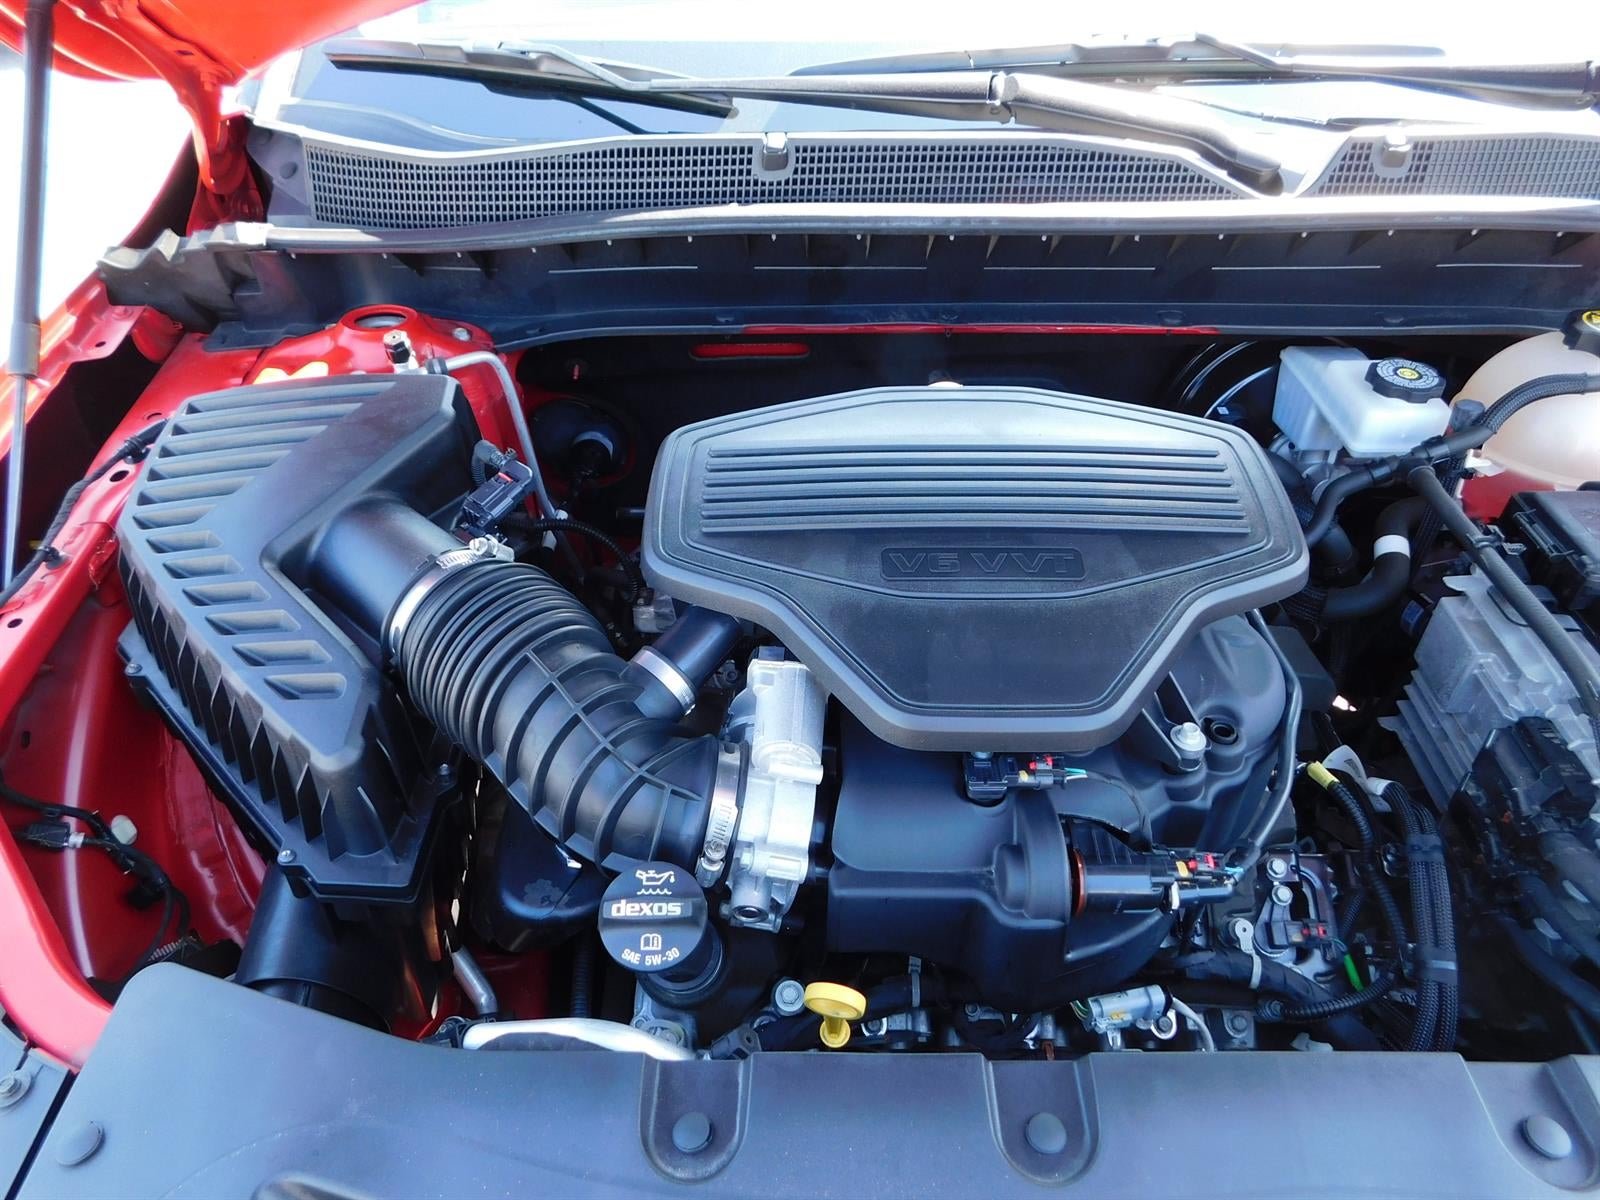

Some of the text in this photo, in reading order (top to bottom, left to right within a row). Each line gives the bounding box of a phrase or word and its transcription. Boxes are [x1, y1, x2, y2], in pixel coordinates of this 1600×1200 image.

[888, 552, 1075, 573] V6 VVT
[611, 899, 682, 917] dexos
[621, 947, 680, 966] SAE 5W-30
